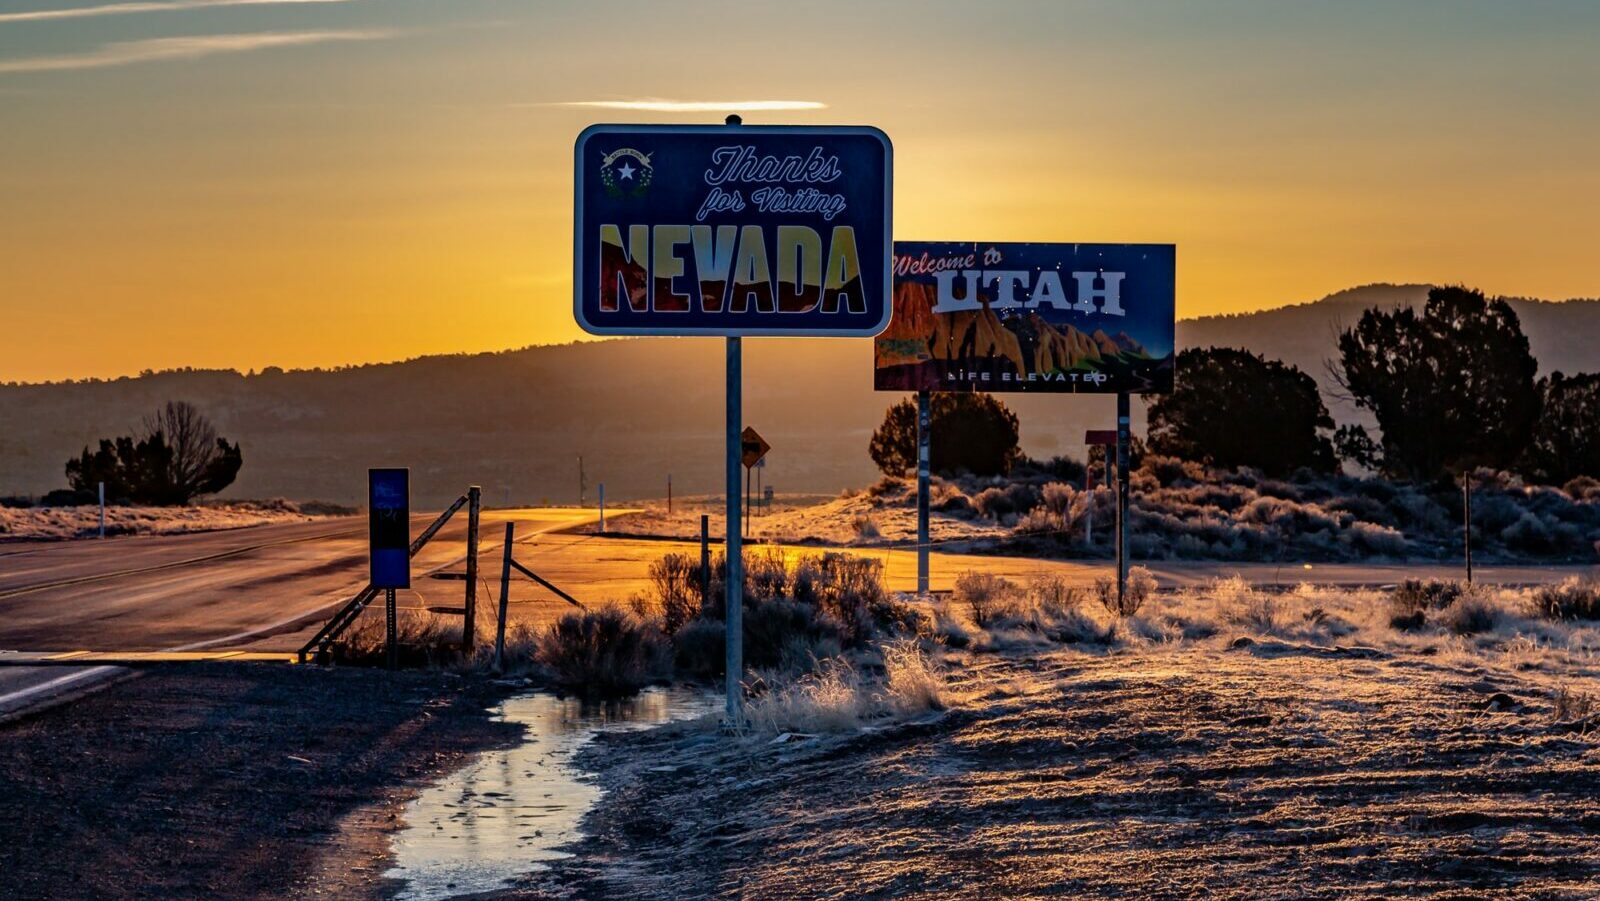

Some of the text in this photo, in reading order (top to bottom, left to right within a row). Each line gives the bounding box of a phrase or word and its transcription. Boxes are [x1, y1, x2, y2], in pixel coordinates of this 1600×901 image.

[704, 145, 842, 185] Thanks
[696, 186, 846, 221] for Visiting
[599, 224, 868, 314] NEVADA
[893, 247, 1002, 276] Welcome to
[931, 270, 1126, 316] UTAH
[948, 371, 1107, 382] LIFE ELEVATED
